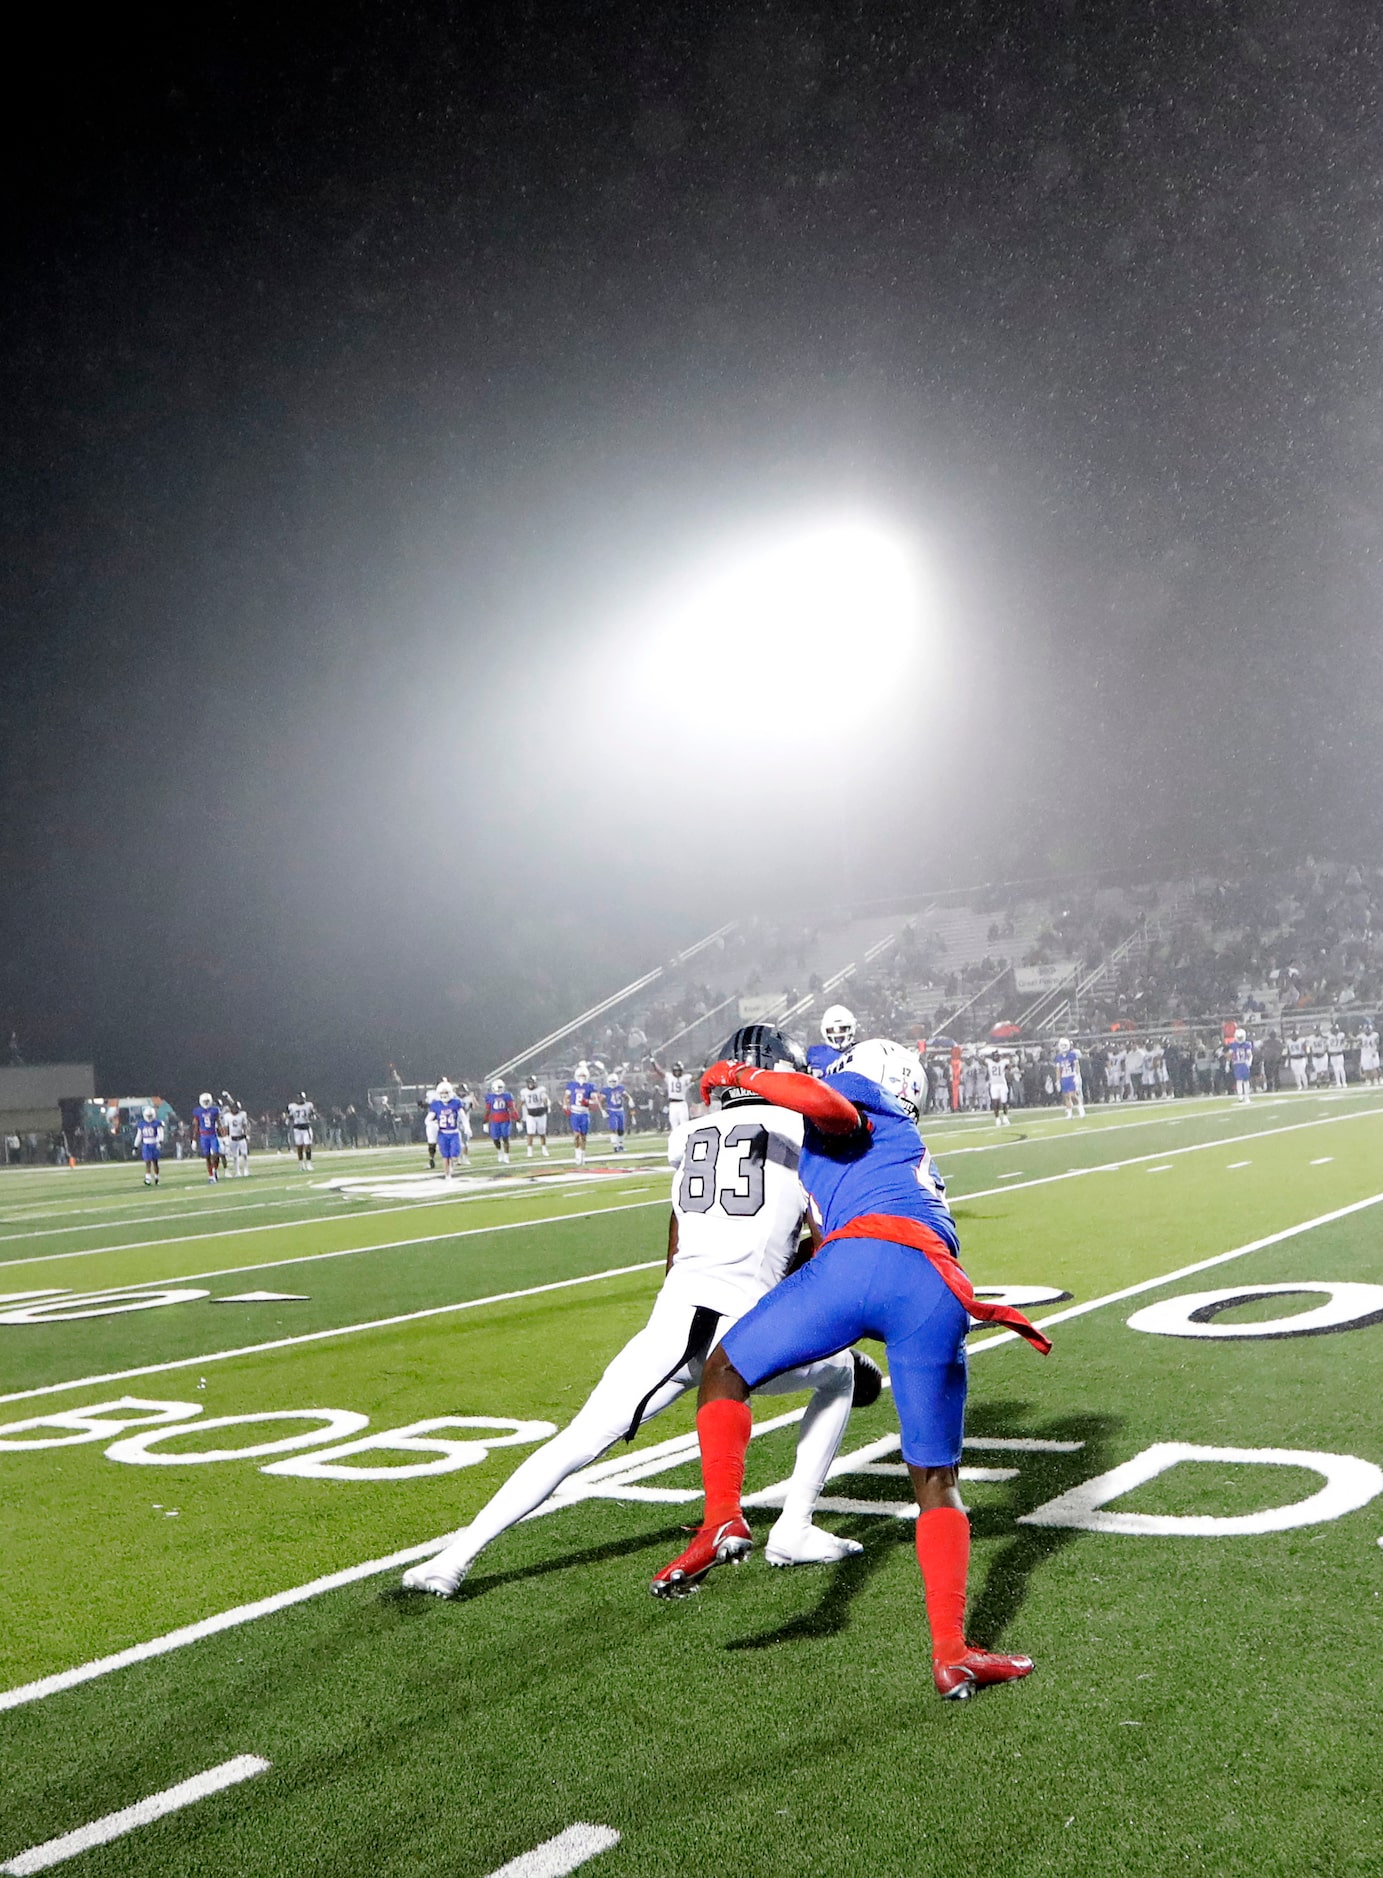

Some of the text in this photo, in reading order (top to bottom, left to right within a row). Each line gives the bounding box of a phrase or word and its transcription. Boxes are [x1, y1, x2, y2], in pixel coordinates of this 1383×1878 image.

[902, 1067, 912, 1077] 17
[991, 1065, 1002, 1077] 21
[670, 1081, 682, 1093] 19
[440, 1114, 455, 1127] 24
[679, 1123, 769, 1217] 83
[0, 1396, 557, 1480] BOB
